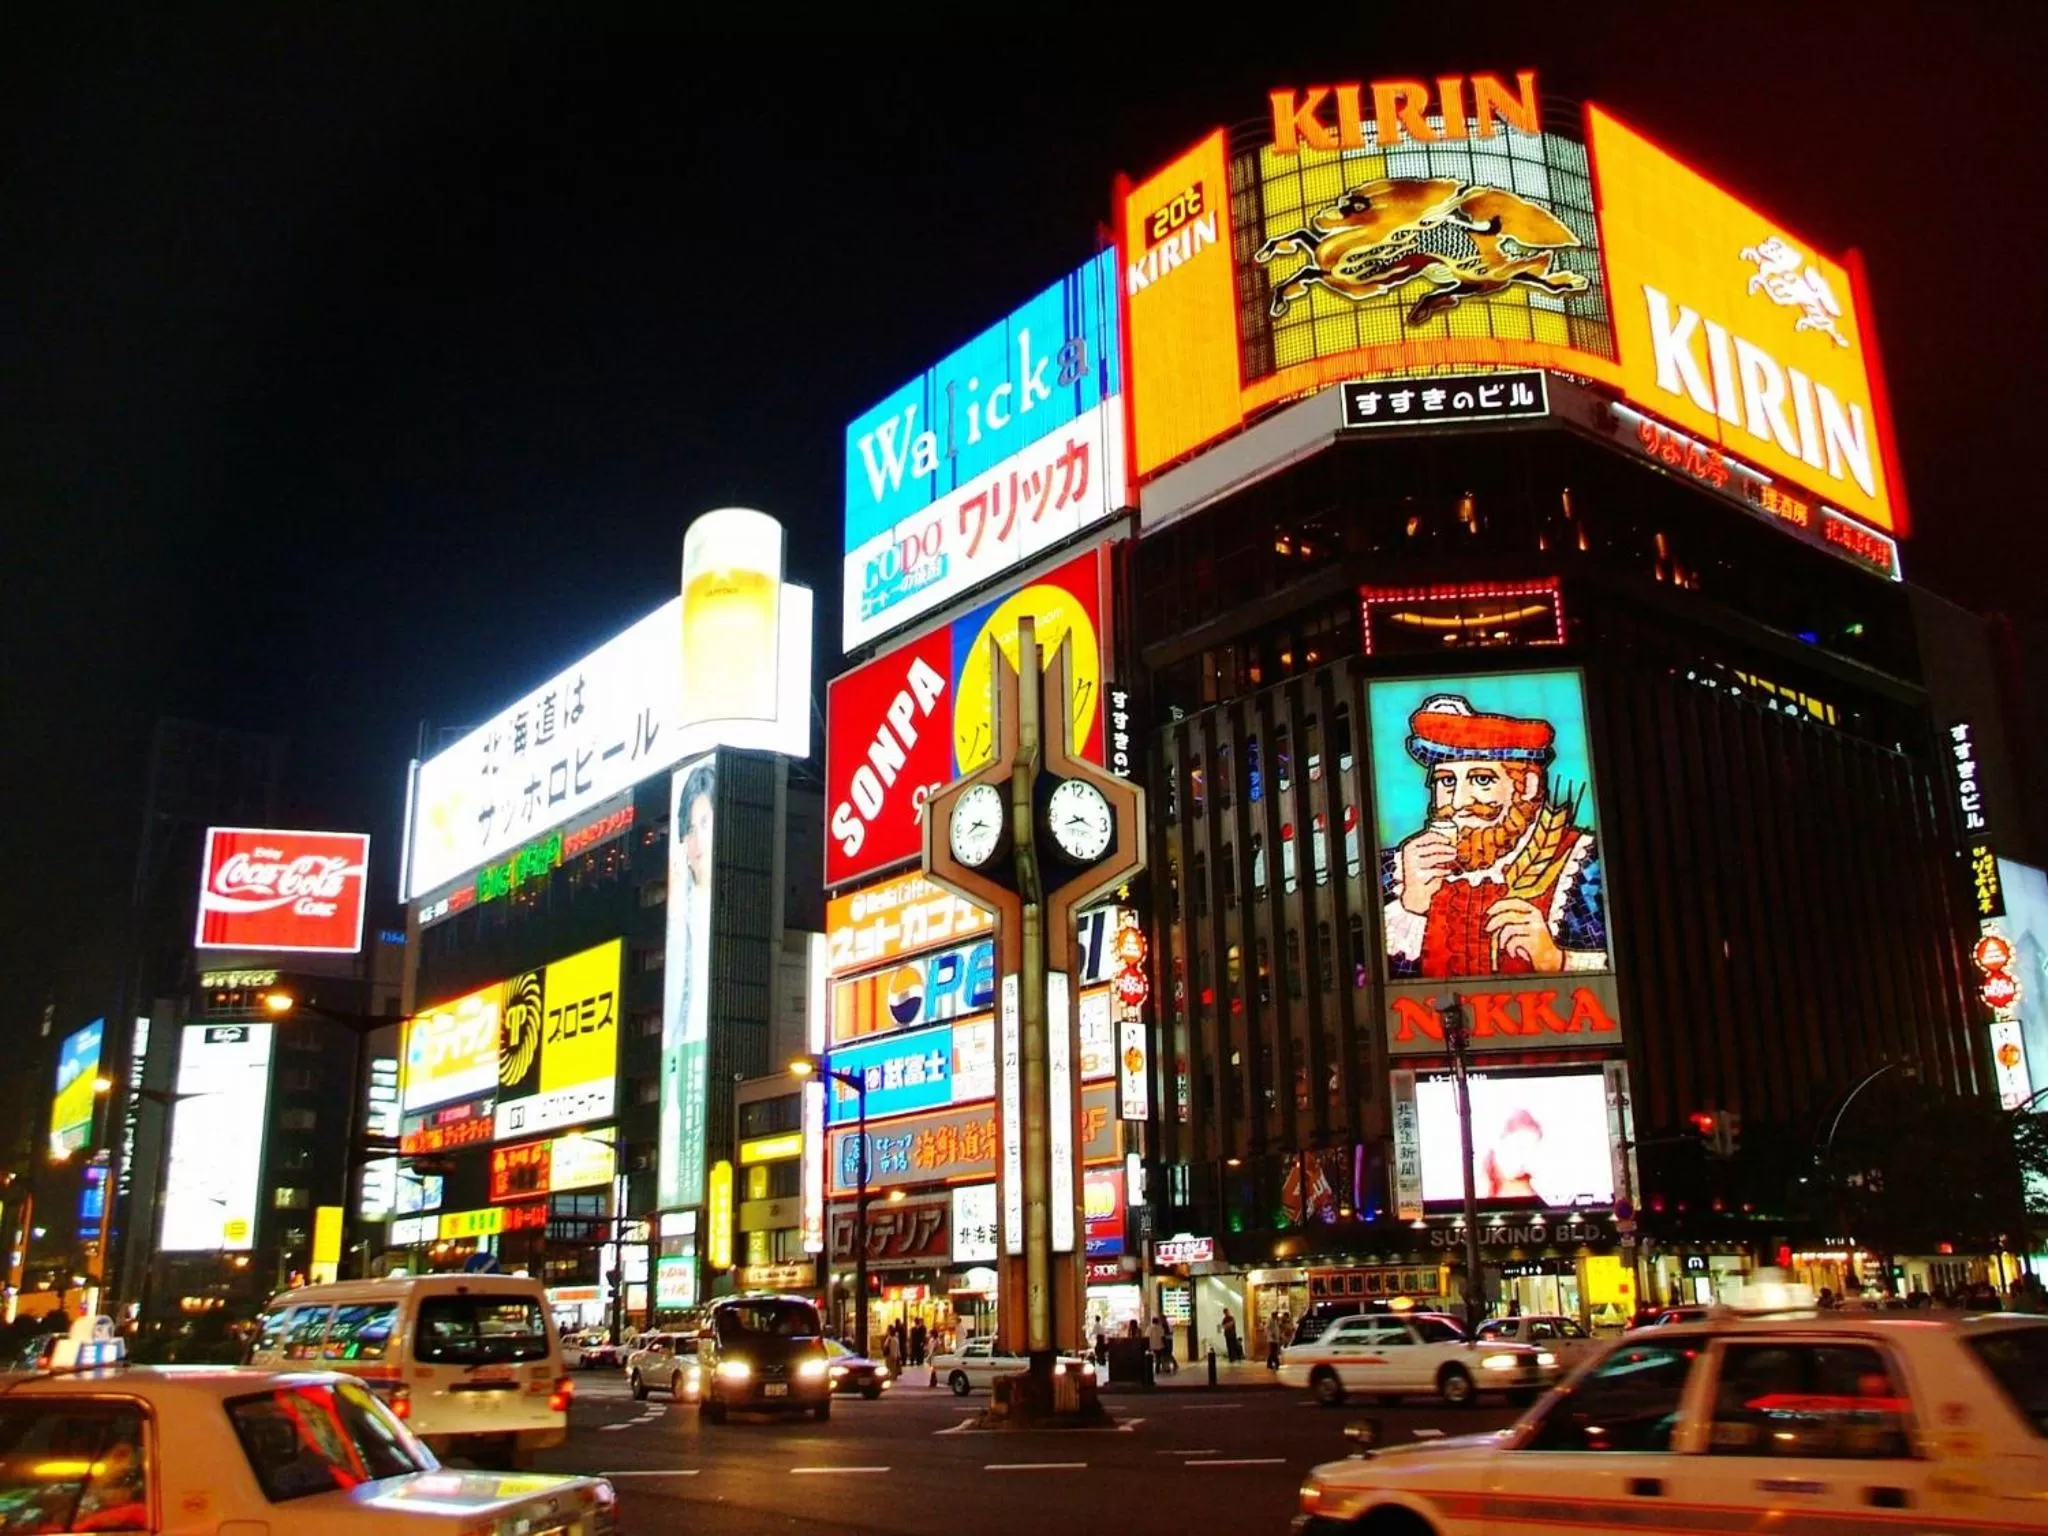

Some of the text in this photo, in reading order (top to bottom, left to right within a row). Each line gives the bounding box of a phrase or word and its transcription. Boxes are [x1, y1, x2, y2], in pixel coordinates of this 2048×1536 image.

[1269, 70, 1541, 154] KIRIN
[1126, 211, 1219, 294] KIRIN
[858, 329, 1088, 503] Walicka
[1355, 383, 1534, 416] すすきのビル
[1642, 284, 1876, 499] KIRIN
[959, 438, 1089, 558] ワリッカ
[481, 672, 585, 776] 北海道は
[831, 656, 946, 857] SONPA
[1950, 723, 1985, 829] すすきのビル
[478, 707, 659, 846] サッポロビール
[216, 852, 347, 897] Coca-Cola
[1390, 987, 1616, 1041] NKKA
[1556, 1223, 1606, 1243] BLD.
